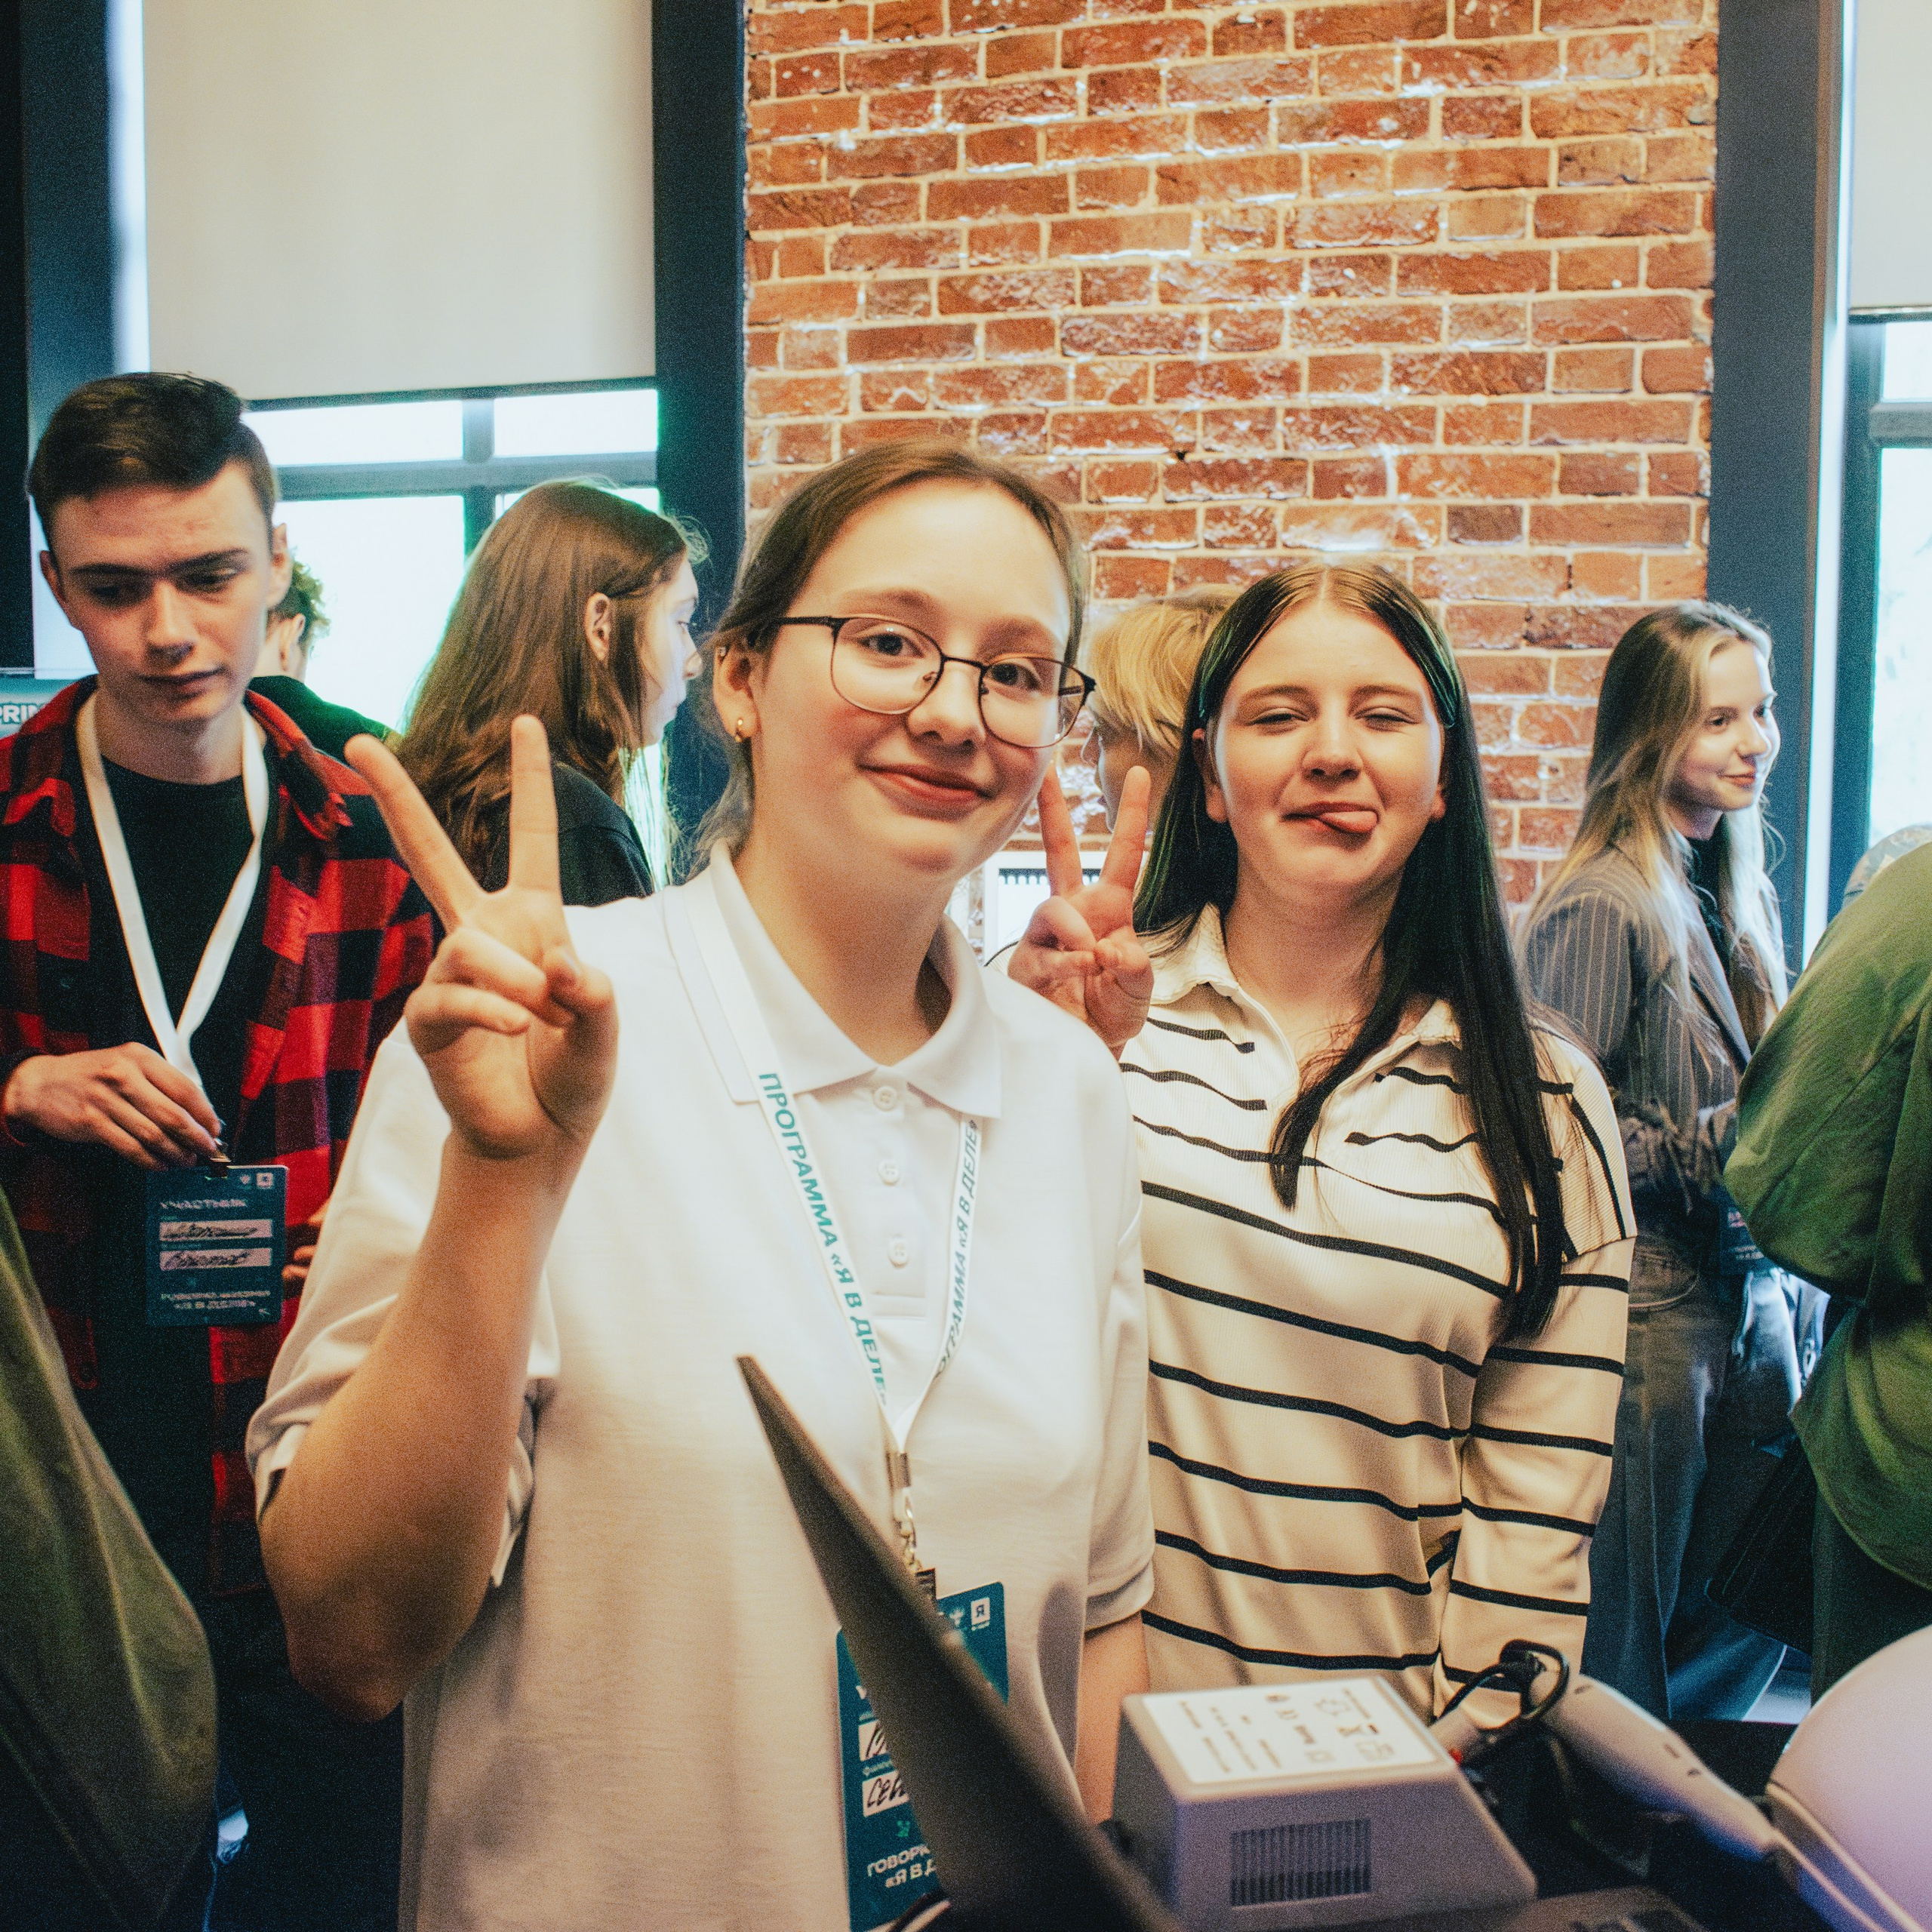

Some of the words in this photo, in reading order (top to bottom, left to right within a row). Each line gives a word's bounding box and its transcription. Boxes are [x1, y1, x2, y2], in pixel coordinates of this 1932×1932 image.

[758, 1072, 838, 1247] ПРОГРАММА
[831, 1252, 854, 1284] «Я
[844, 1291, 863, 1309] В
[958, 1195, 971, 1217] В
[976, 1604, 985, 1618] Я
[910, 1863, 922, 1880] В
